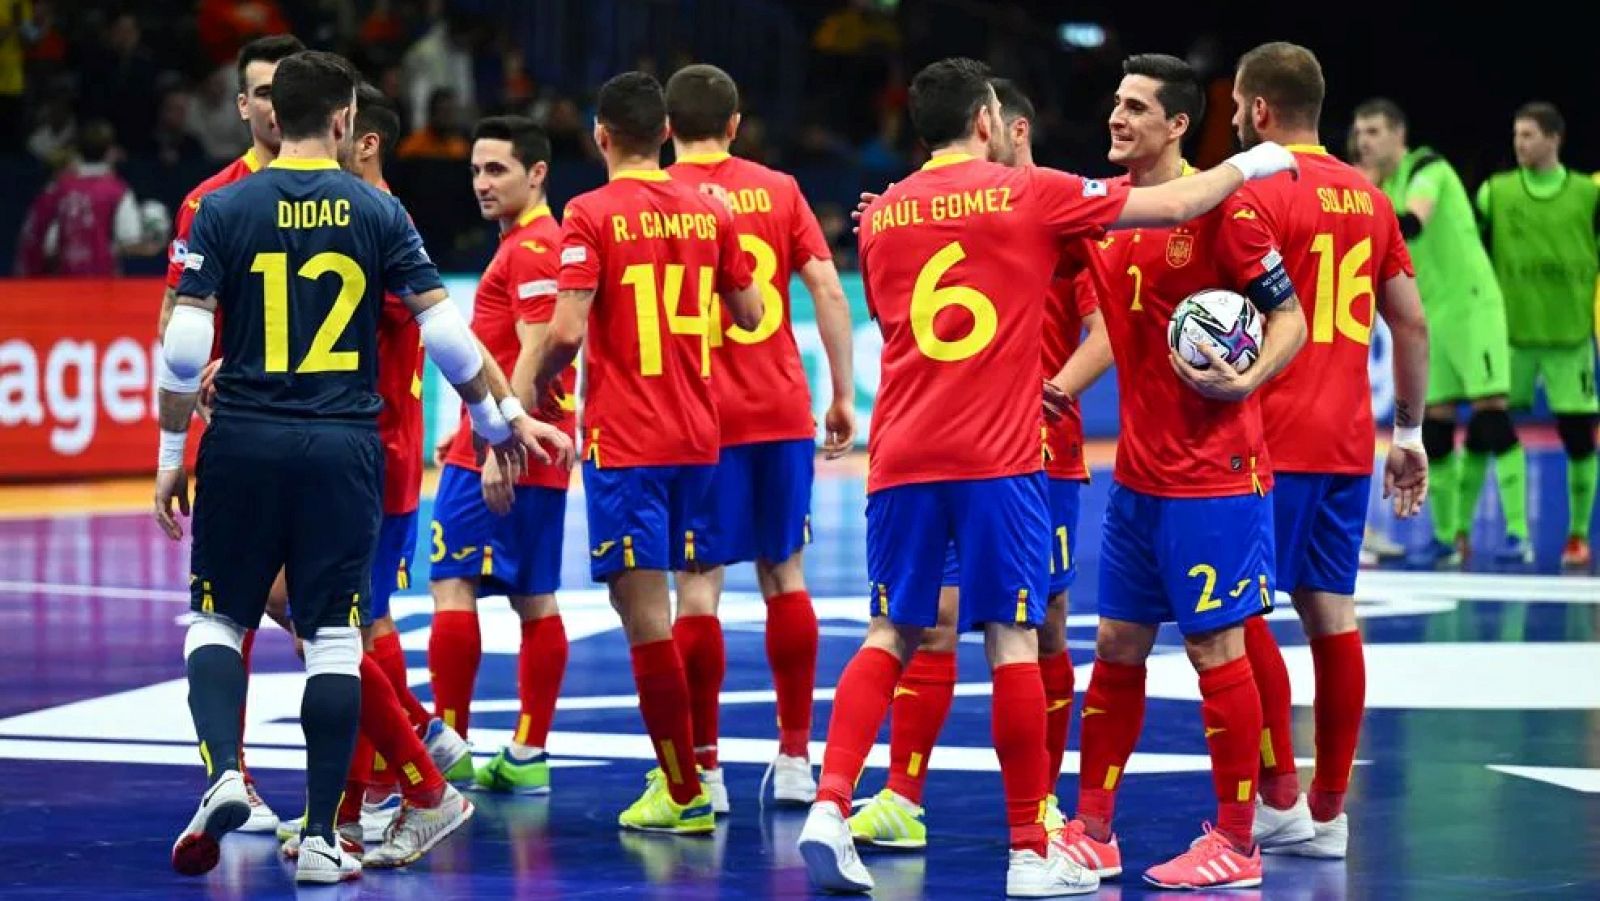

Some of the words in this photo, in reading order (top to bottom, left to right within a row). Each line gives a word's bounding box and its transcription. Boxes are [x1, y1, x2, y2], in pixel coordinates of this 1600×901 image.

[278, 200, 350, 228] DIDAC
[612, 214, 635, 242] R.
[642, 211, 717, 240] CAMPOS
[872, 203, 922, 234] RAÚL
[931, 187, 1012, 221] GOMEZ
[1317, 187, 1374, 216] SOLANO
[250, 252, 366, 372] 12
[910, 241, 998, 361] 6
[1310, 233, 1376, 345] 16
[622, 264, 714, 378] 14
[1187, 563, 1222, 613] 2
